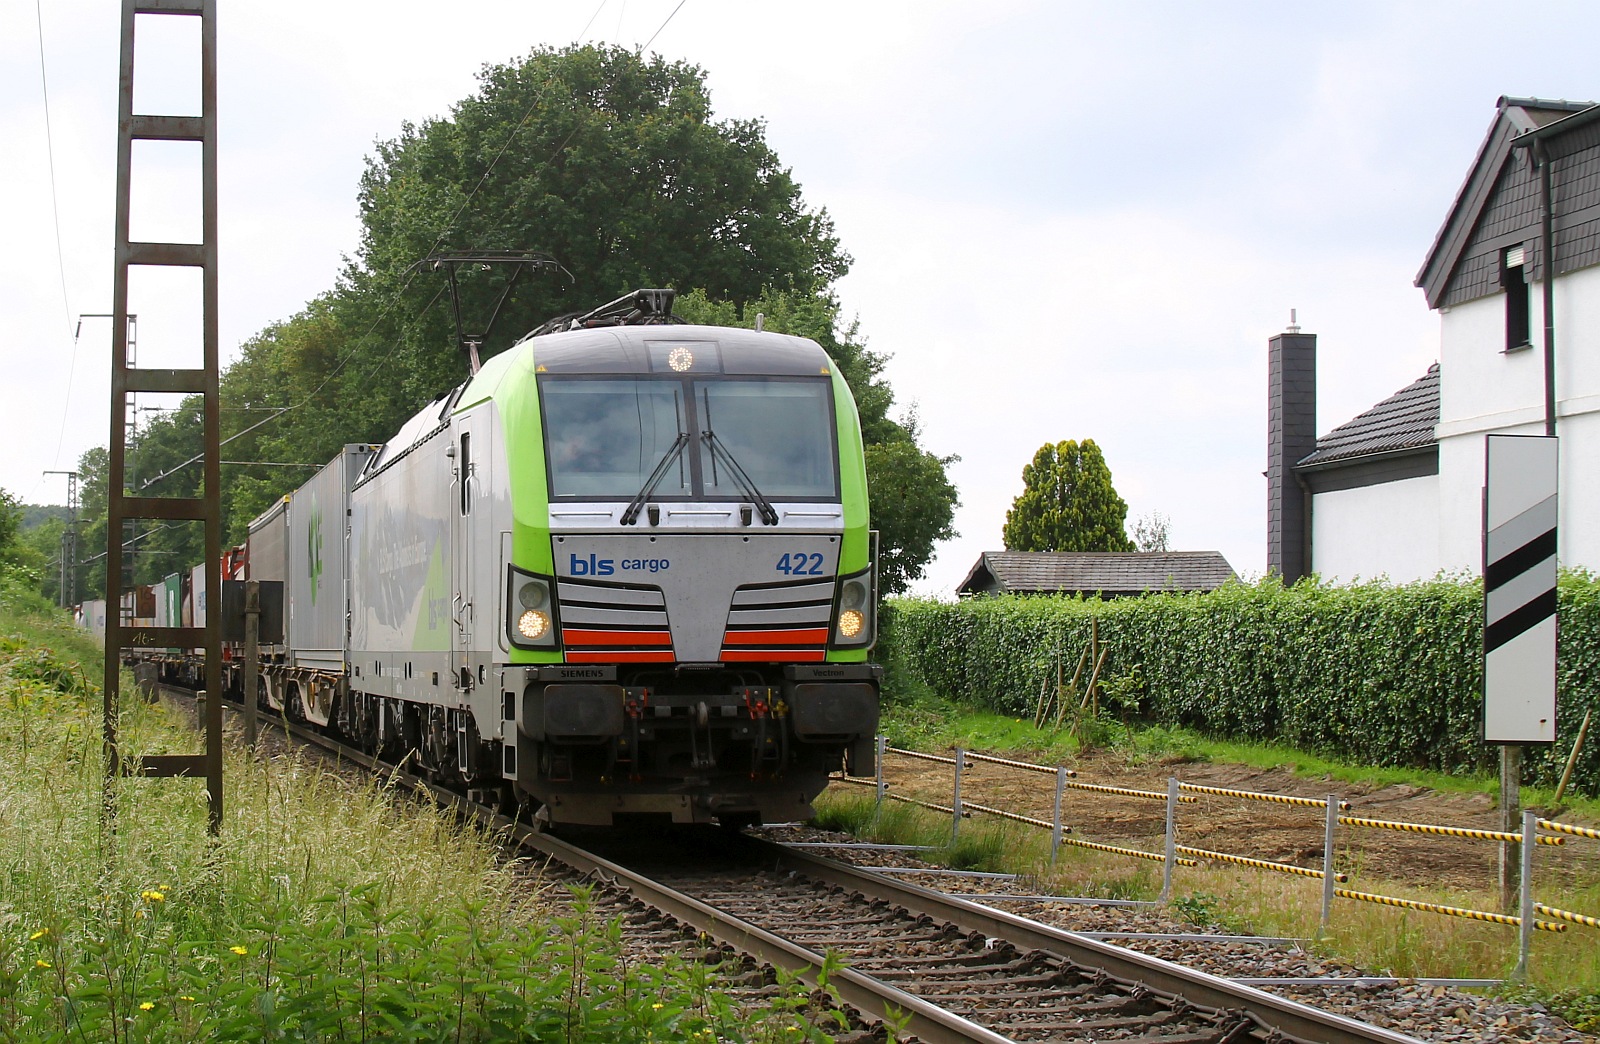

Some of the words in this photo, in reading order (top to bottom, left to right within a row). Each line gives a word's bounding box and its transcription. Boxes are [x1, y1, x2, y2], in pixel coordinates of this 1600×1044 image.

[570, 553, 615, 576] bls
[621, 557, 670, 573] cargo
[776, 553, 824, 575] 422
[560, 669, 604, 678] SIEMENS
[812, 668, 845, 677] Vectron
